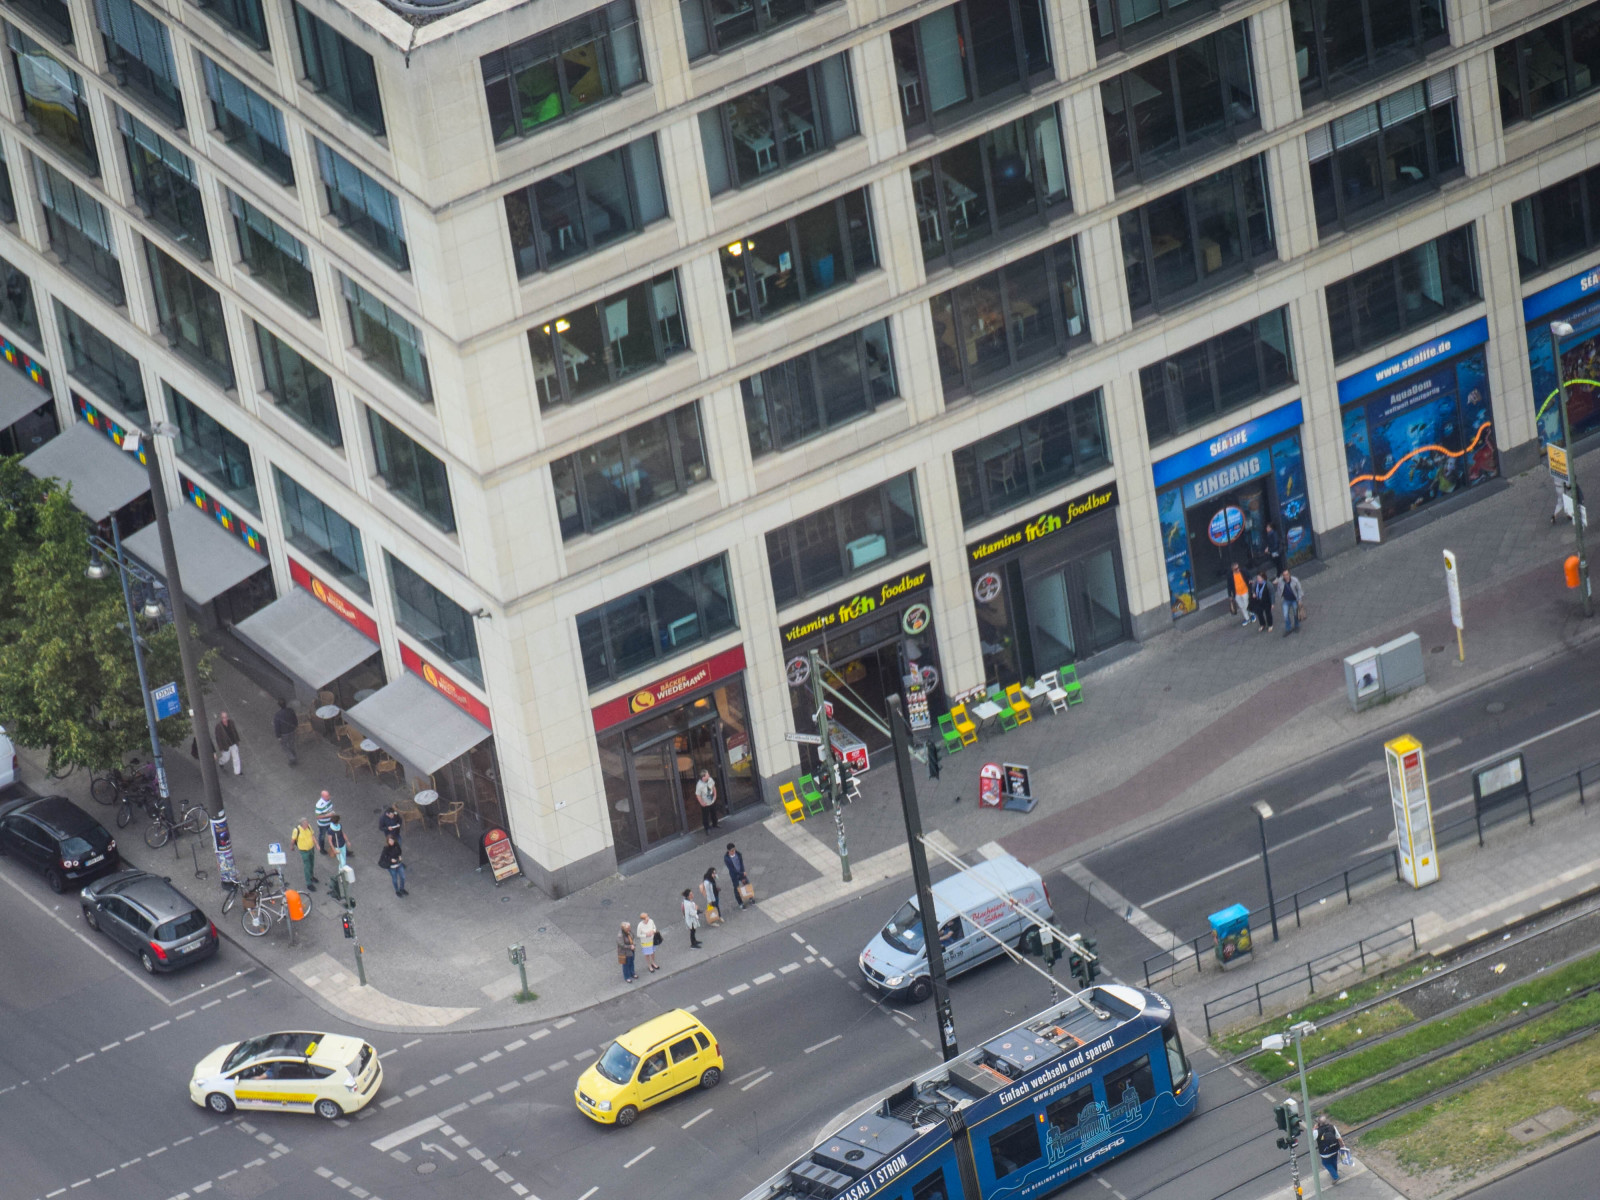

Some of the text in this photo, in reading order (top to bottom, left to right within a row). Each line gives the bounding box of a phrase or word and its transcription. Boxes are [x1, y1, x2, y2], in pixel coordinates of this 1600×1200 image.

[1375, 340, 1452, 382] www.sealife.de
[1209, 437, 1229, 458] SEA
[1193, 456, 1261, 500] EINGANG
[972, 530, 1022, 561] vitamins
[1065, 491, 1112, 525] foodbar
[785, 612, 836, 642] vitamins
[879, 572, 926, 606] foodbar
[656, 669, 707, 701] WIEDEMANN
[998, 1035, 1115, 1106] Einfach wechseln und sparen!
[1032, 1066, 1093, 1103] www.gasag.de/strom
[876, 1153, 908, 1184] STROM
[1083, 1136, 1125, 1163] GASAG
